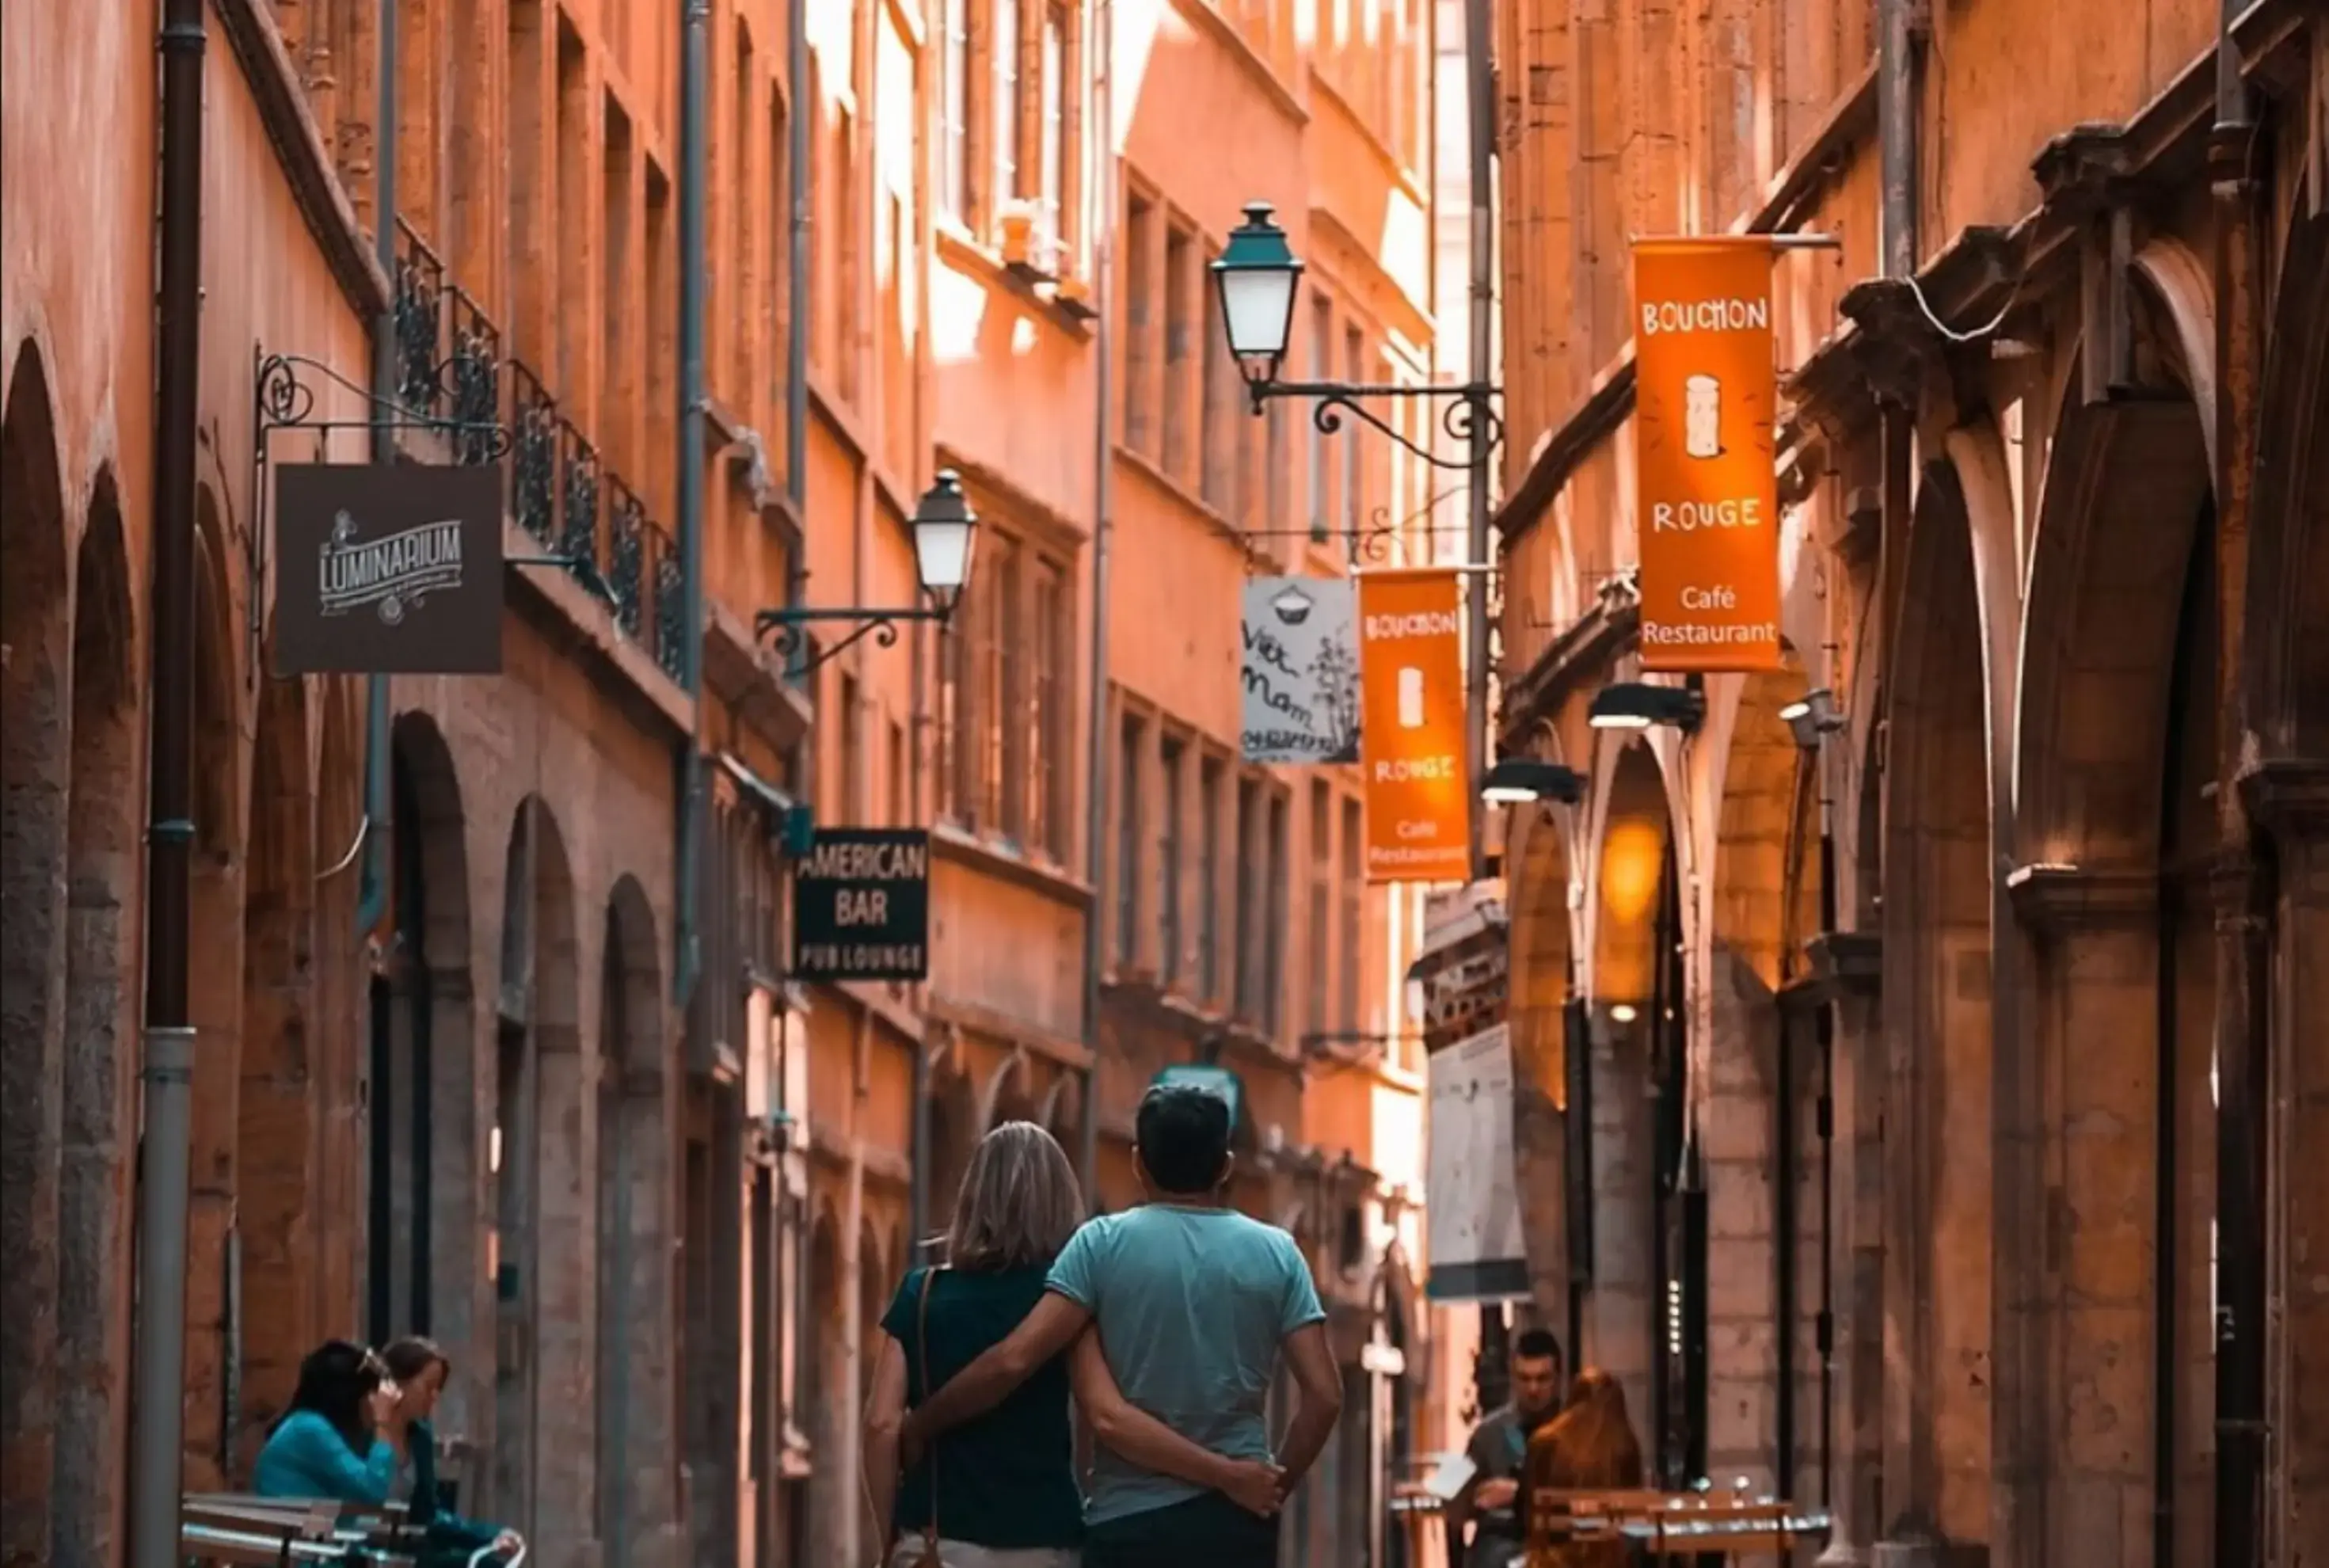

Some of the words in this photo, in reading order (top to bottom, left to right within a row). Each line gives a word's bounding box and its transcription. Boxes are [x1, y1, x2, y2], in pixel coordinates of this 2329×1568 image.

[1642, 297, 1768, 336] BOUCHON
[1653, 498, 1761, 533] ROUGE
[320, 525, 461, 593] LUMINARIUM
[1680, 584, 1736, 610] Café
[1642, 621, 1776, 645] Restaurant
[1375, 755, 1457, 784] ROUGE
[797, 843, 925, 880] AMERICAN
[835, 889, 888, 927] BAR
[800, 945, 838, 971] PUB
[842, 944, 922, 970] LOUNGE
